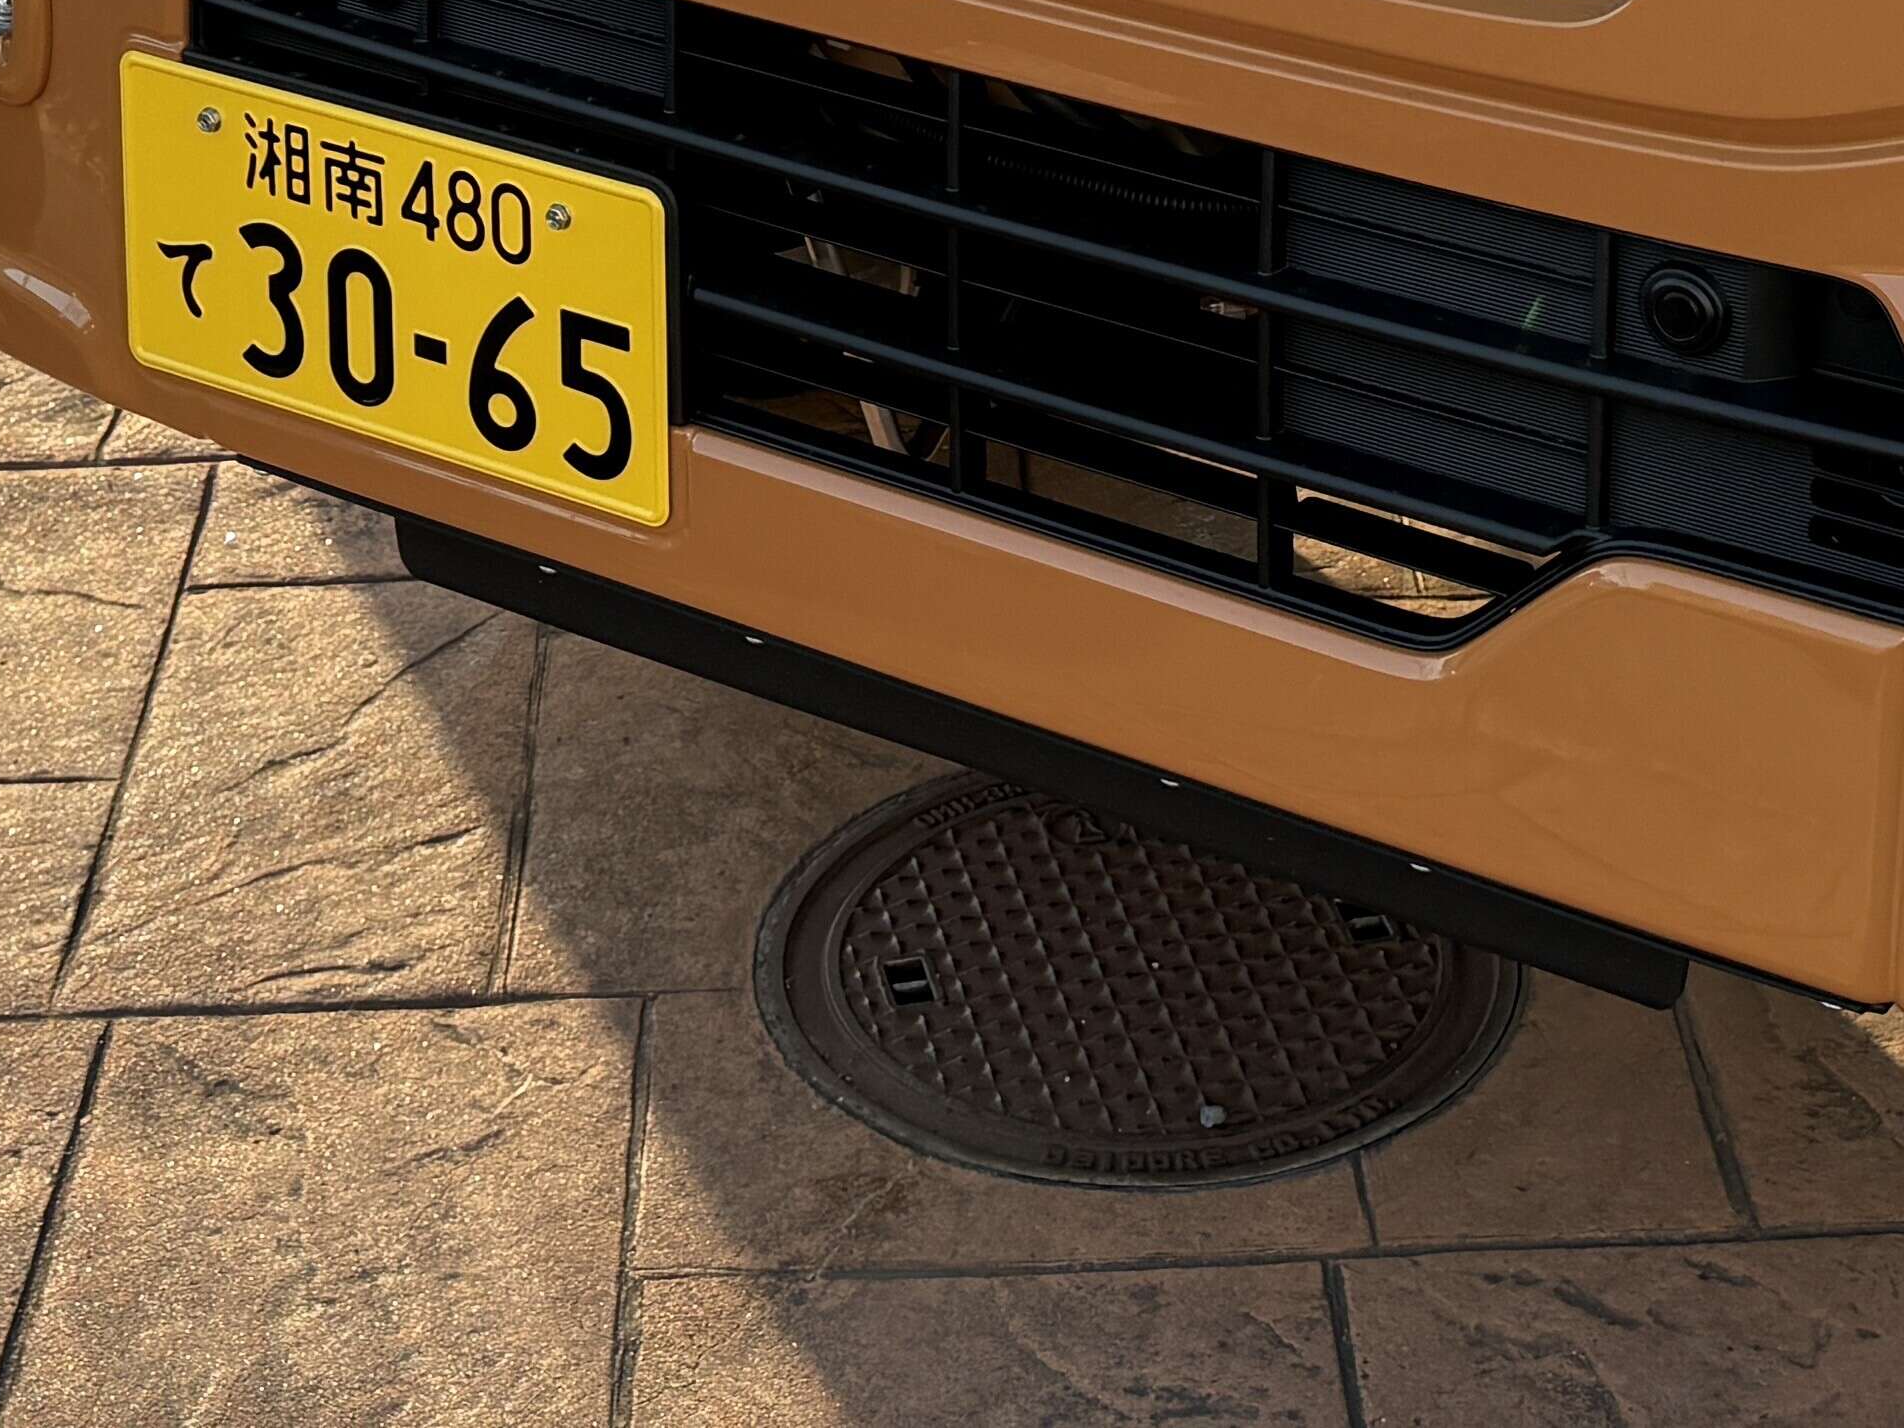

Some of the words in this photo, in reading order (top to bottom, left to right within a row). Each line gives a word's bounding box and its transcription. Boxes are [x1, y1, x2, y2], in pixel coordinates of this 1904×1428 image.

[244, 111, 386, 227] 湘南
[400, 160, 534, 265] 480
[157, 240, 214, 319] て
[238, 221, 634, 481] 30-65
